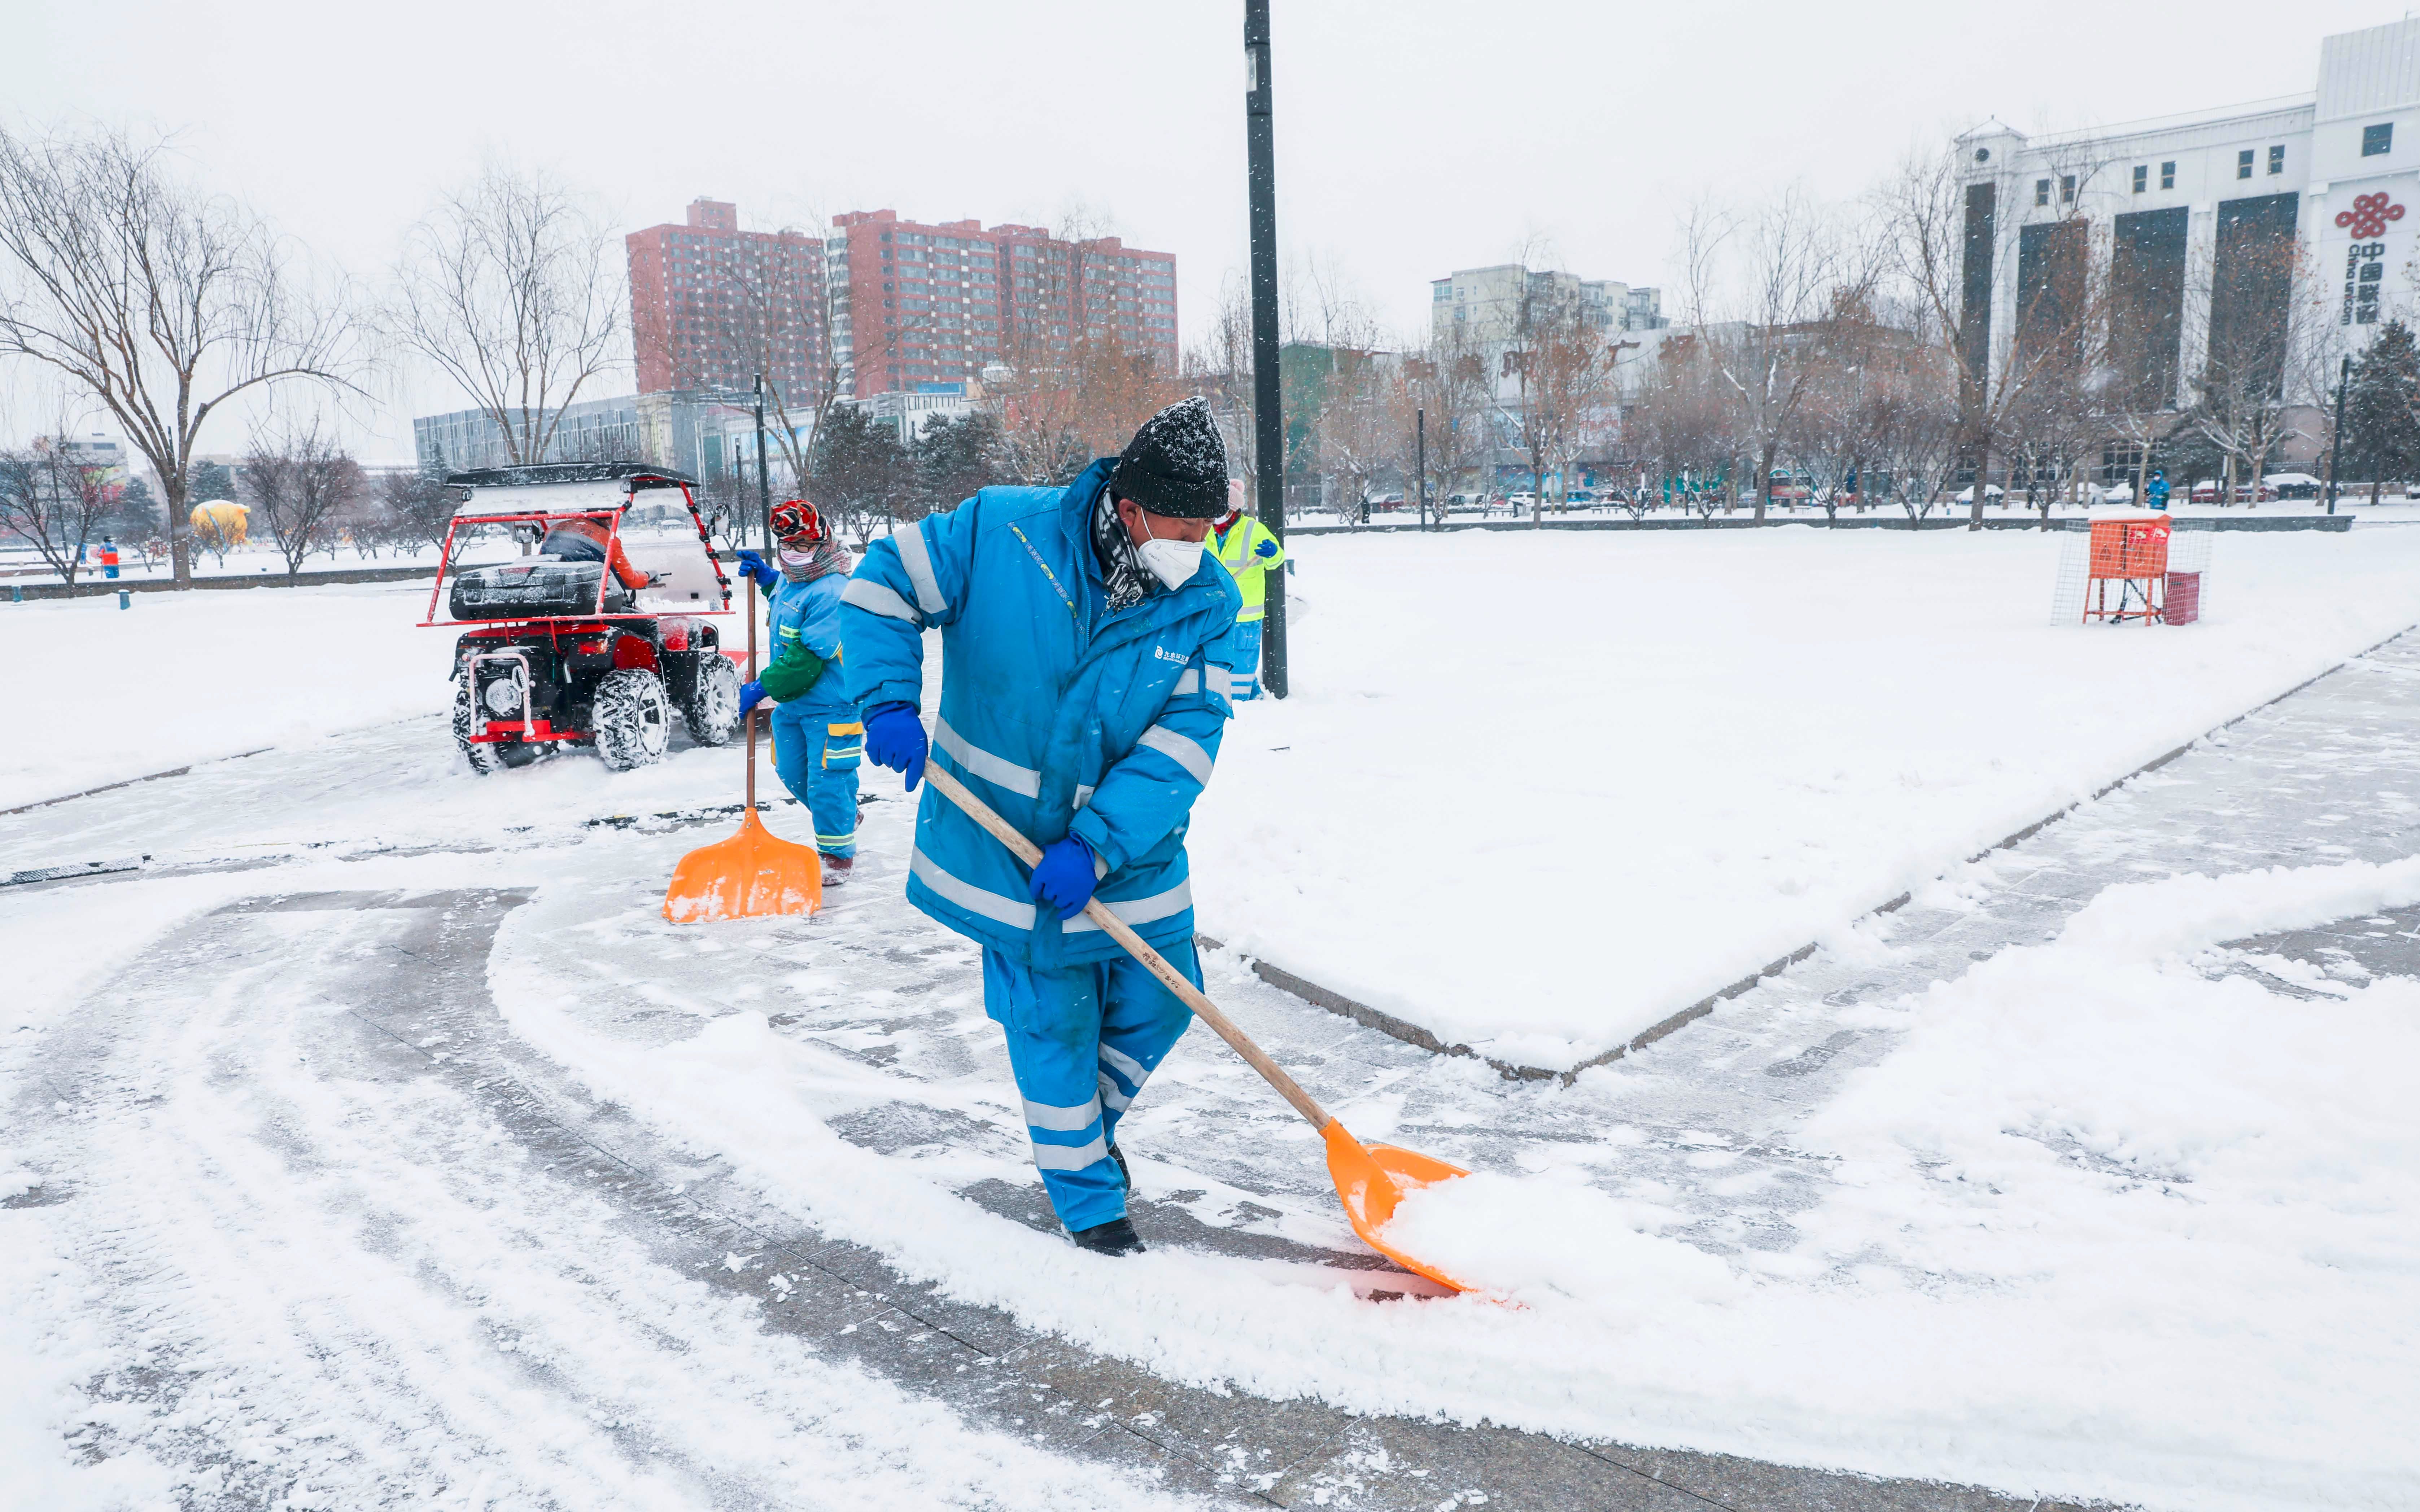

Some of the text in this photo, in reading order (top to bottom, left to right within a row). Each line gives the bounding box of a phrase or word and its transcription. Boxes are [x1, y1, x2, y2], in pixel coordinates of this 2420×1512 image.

[2346, 244, 2360, 279] China
[2356, 242, 2385, 324] 中国联通
